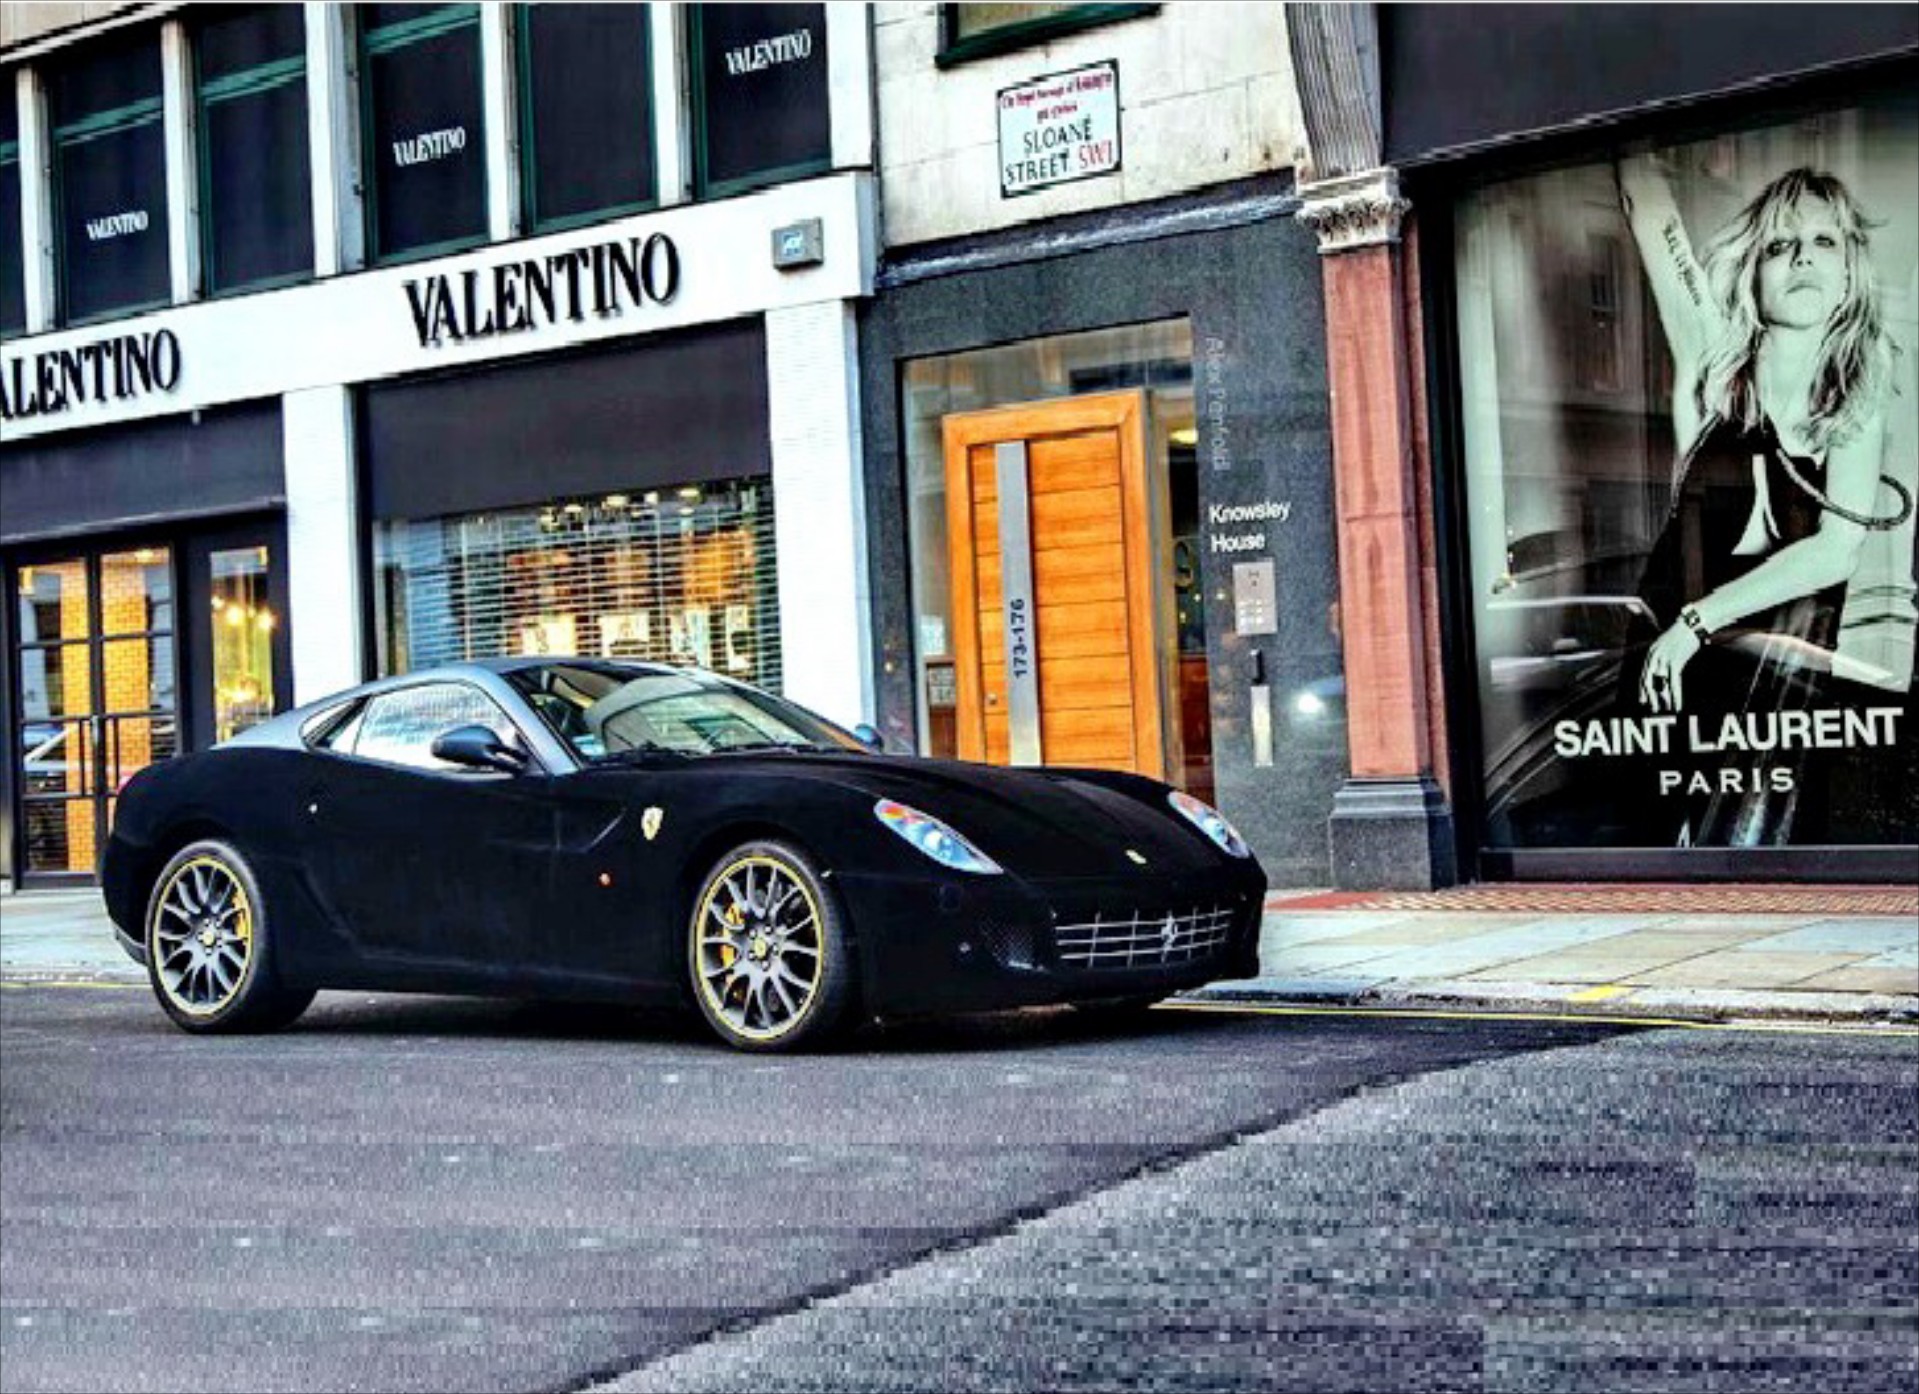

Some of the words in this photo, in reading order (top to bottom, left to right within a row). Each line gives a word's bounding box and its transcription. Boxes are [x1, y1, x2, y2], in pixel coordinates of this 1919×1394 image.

[725, 28, 811, 75] VALENTINO
[393, 126, 465, 167] VALENTINO
[1023, 114, 1091, 155] SLOANE
[1005, 149, 1069, 185] STREET
[1079, 140, 1112, 170] SW1
[86, 210, 148, 240] VALENTINO
[402, 232, 680, 348] VALENTINO
[1209, 499, 1292, 525] Knowsley
[1211, 532, 1266, 553] House
[1010, 599, 1027, 679] 173-176
[1554, 715, 1677, 757] SAINT
[1688, 707, 1905, 752] LAURENT
[1659, 767, 1796, 796] PARIS
